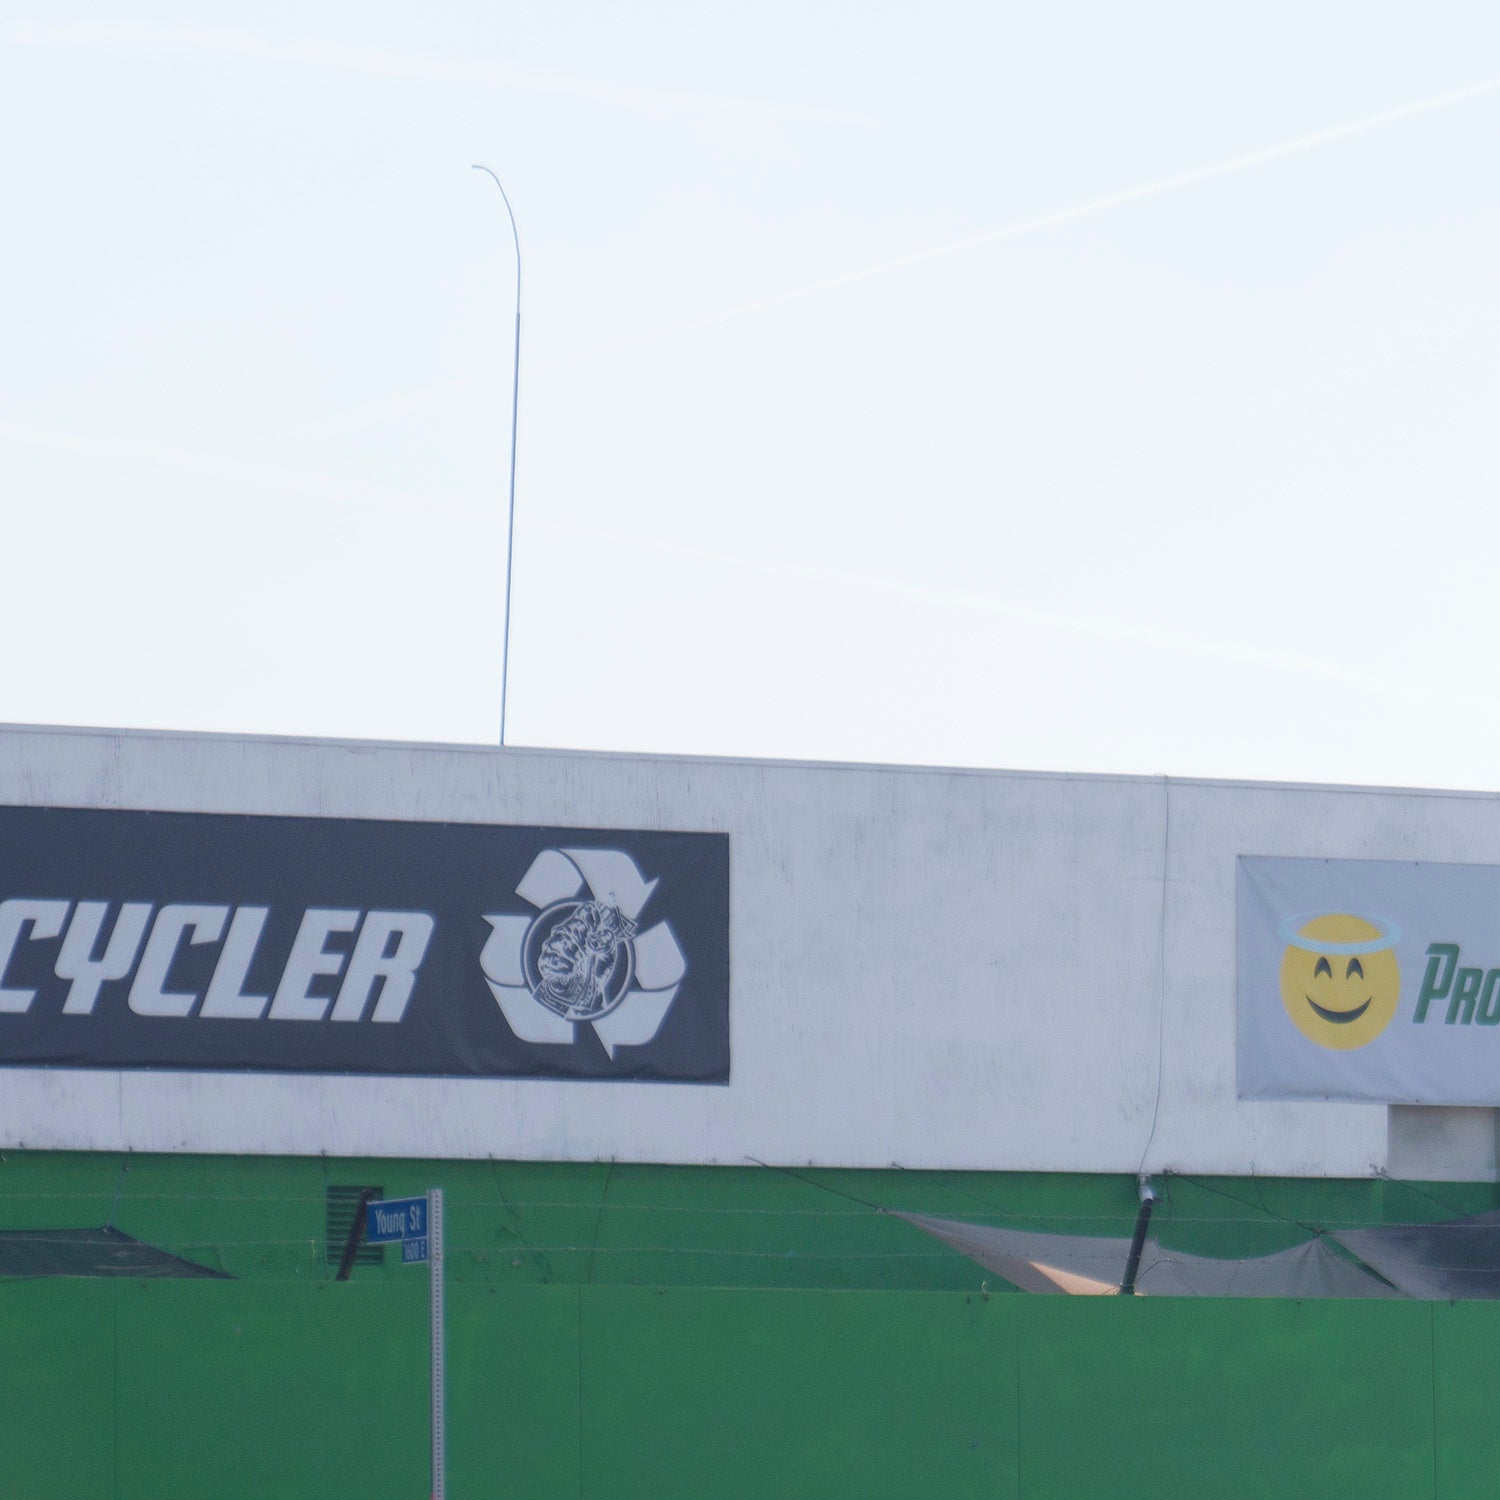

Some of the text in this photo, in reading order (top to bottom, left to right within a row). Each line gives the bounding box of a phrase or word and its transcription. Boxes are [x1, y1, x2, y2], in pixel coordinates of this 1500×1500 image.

[0, 898, 435, 1023] CYCLER
[375, 1204, 421, 1239] Young St
